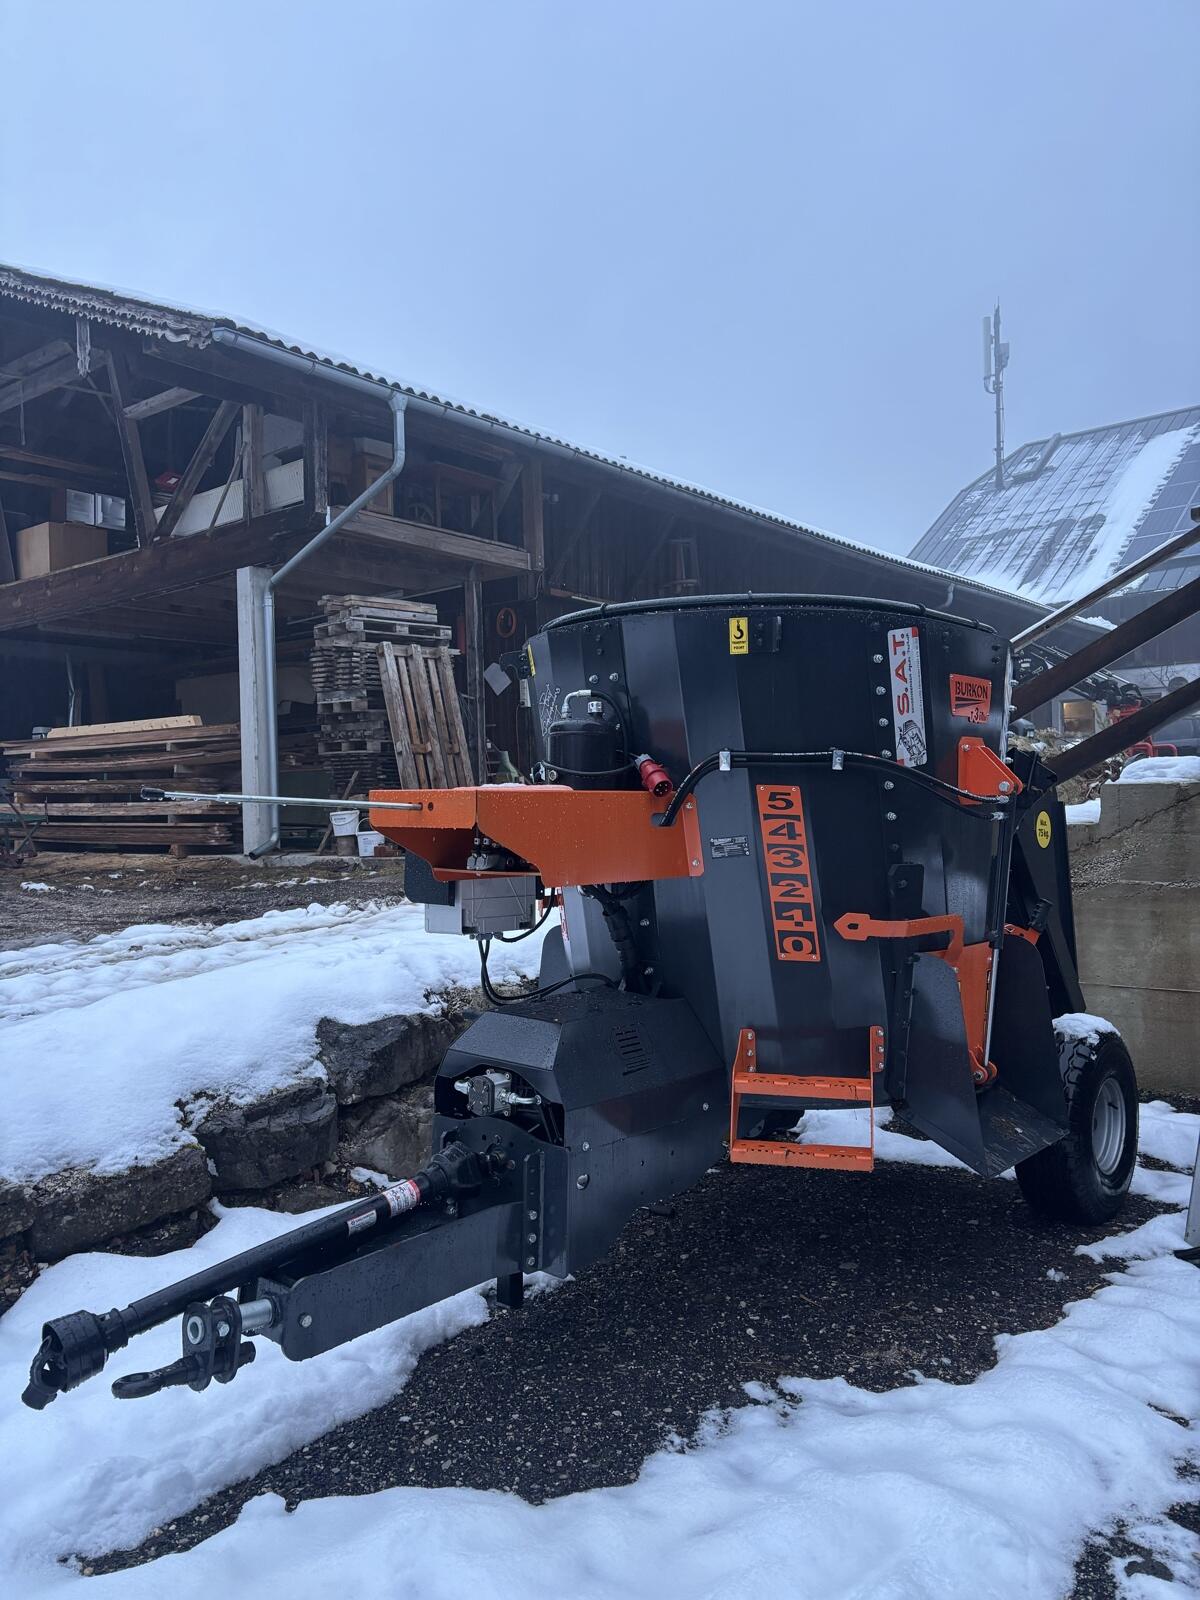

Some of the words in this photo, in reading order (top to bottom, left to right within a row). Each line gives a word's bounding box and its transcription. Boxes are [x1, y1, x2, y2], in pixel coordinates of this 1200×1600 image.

[892, 633, 909, 716] S.A.T.
[955, 681, 988, 699] BURKON
[768, 792, 794, 810] 5
[768, 822, 802, 840] 4
[769, 847, 804, 868] 3
[777, 880, 805, 898] 2
[781, 909, 805, 927] 1
[782, 935, 813, 956] 0
